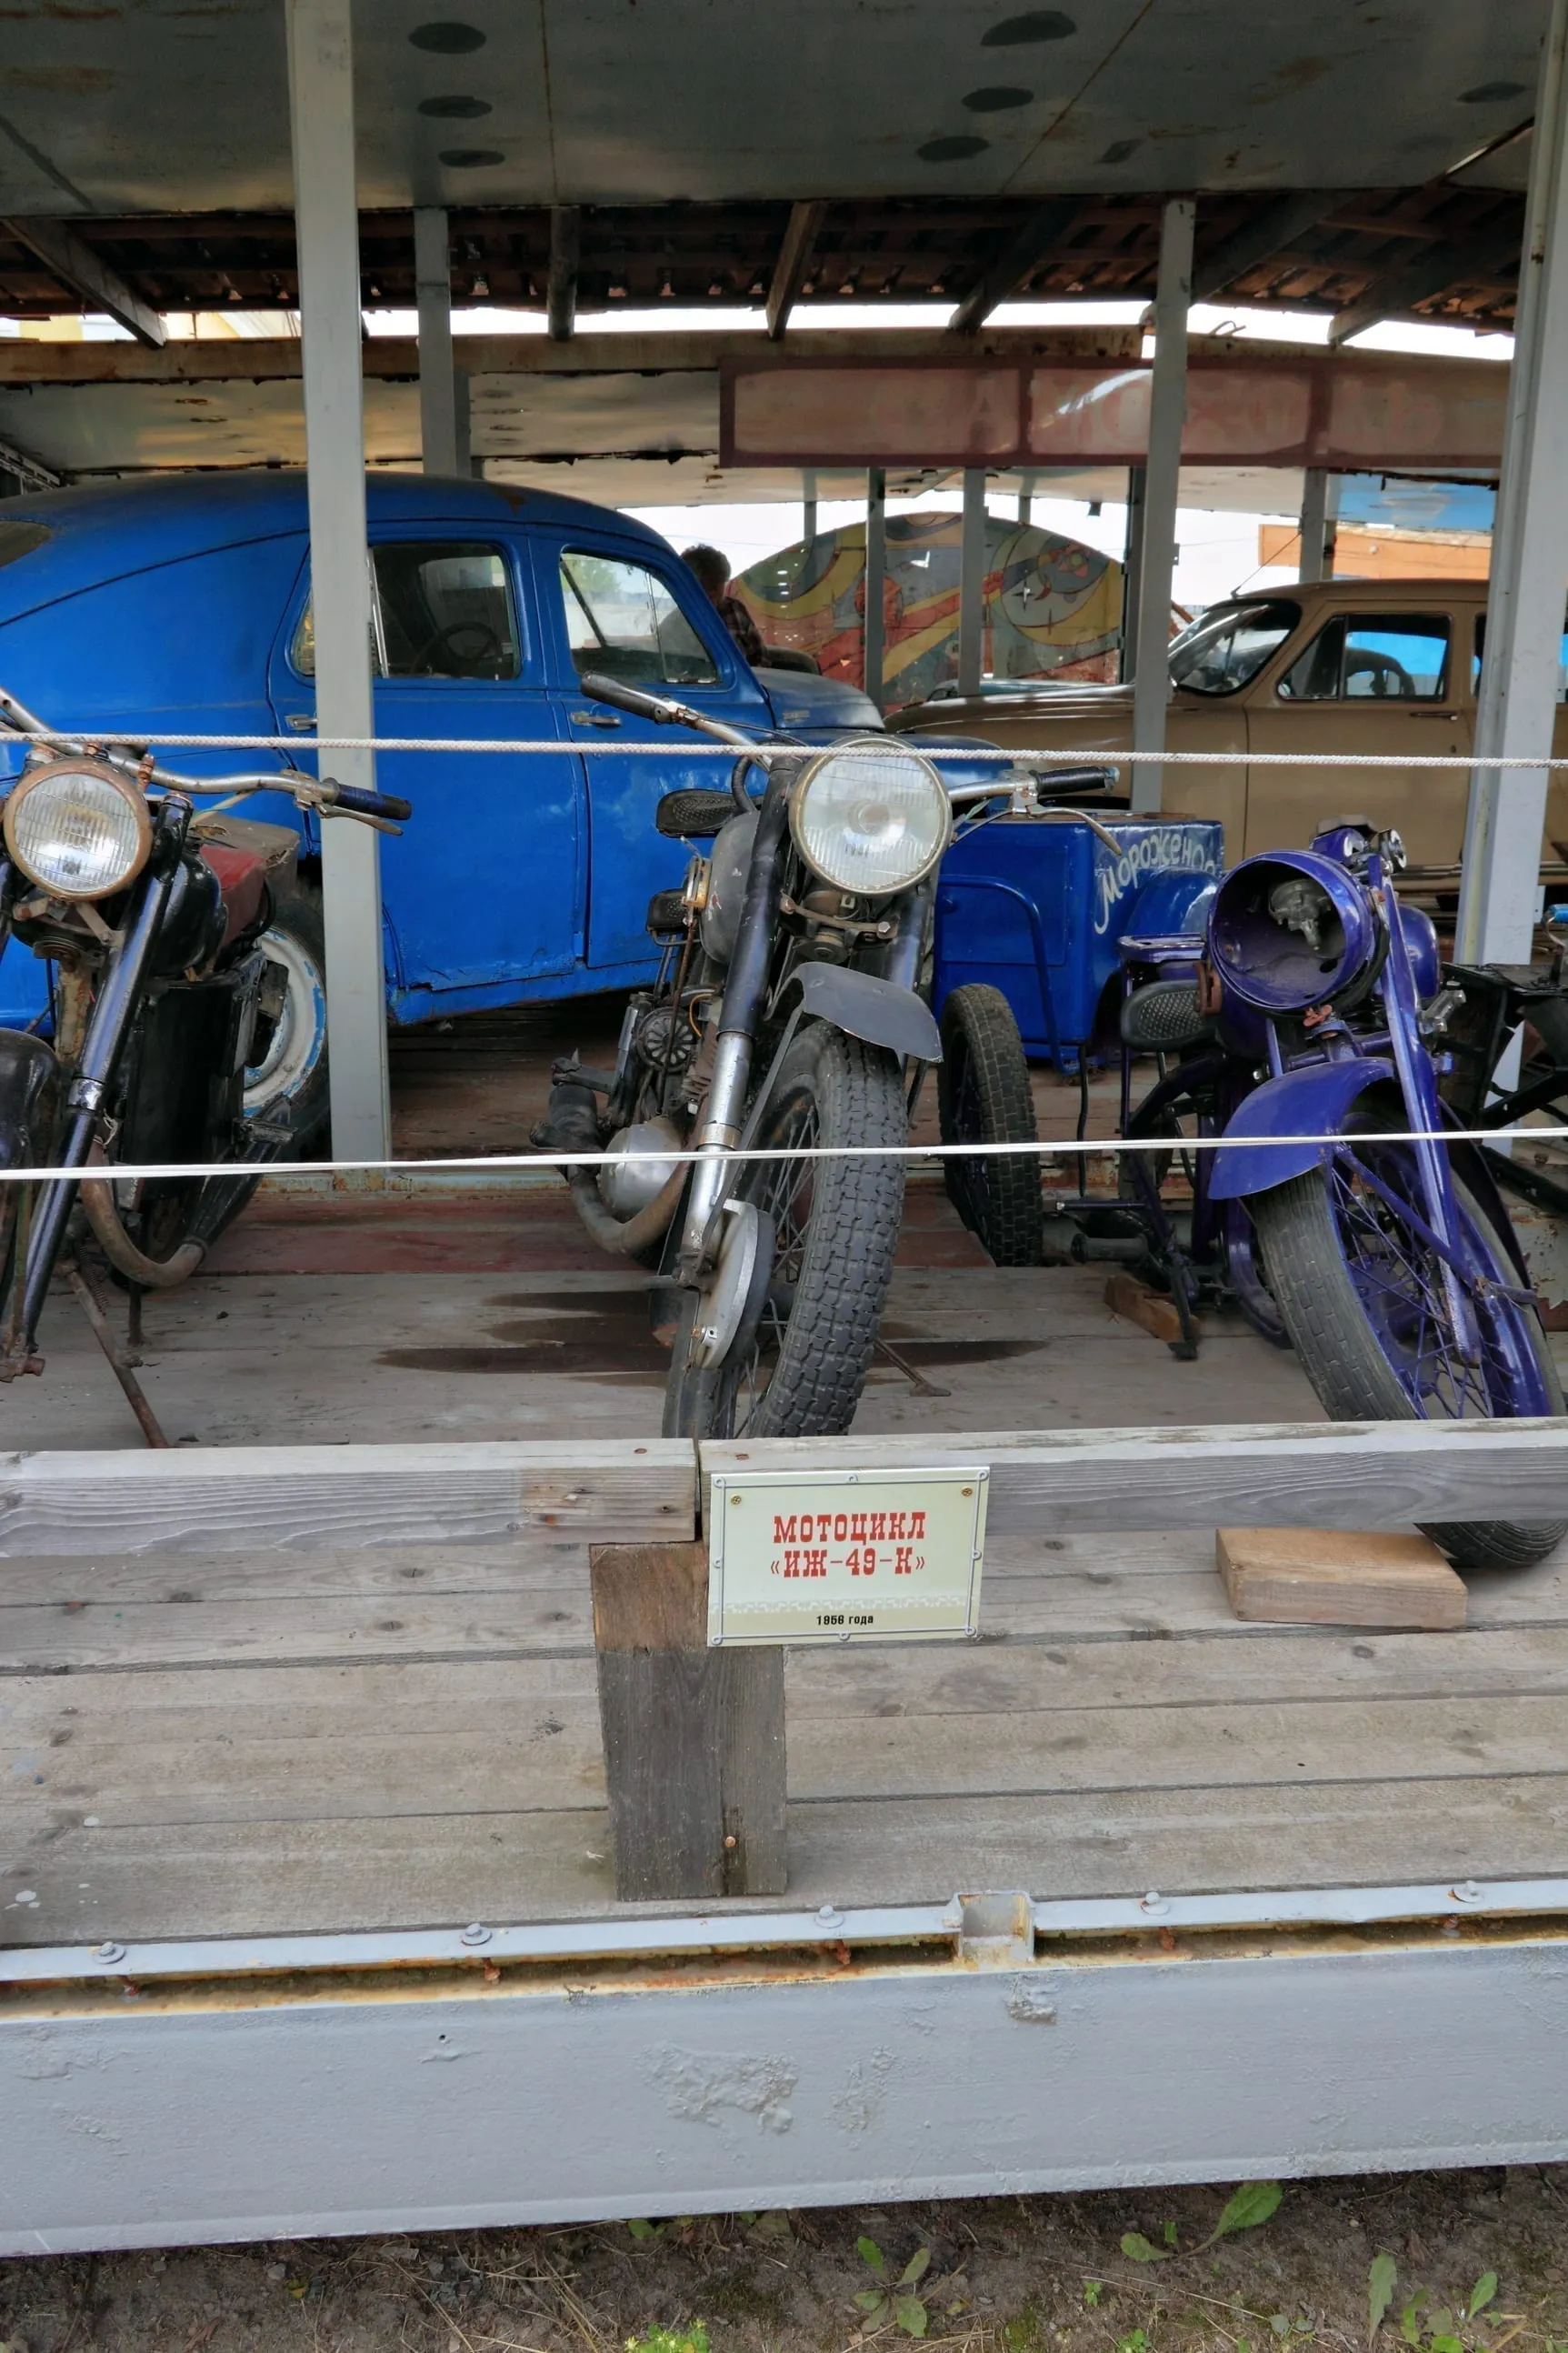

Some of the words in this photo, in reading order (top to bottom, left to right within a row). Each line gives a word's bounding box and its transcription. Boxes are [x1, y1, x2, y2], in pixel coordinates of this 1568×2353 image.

[774, 1512, 926, 1546] МОТОЦИКЛ
[770, 1547, 925, 1578] «ИЖ-49-К»
[848, 1615, 874, 1626] года
